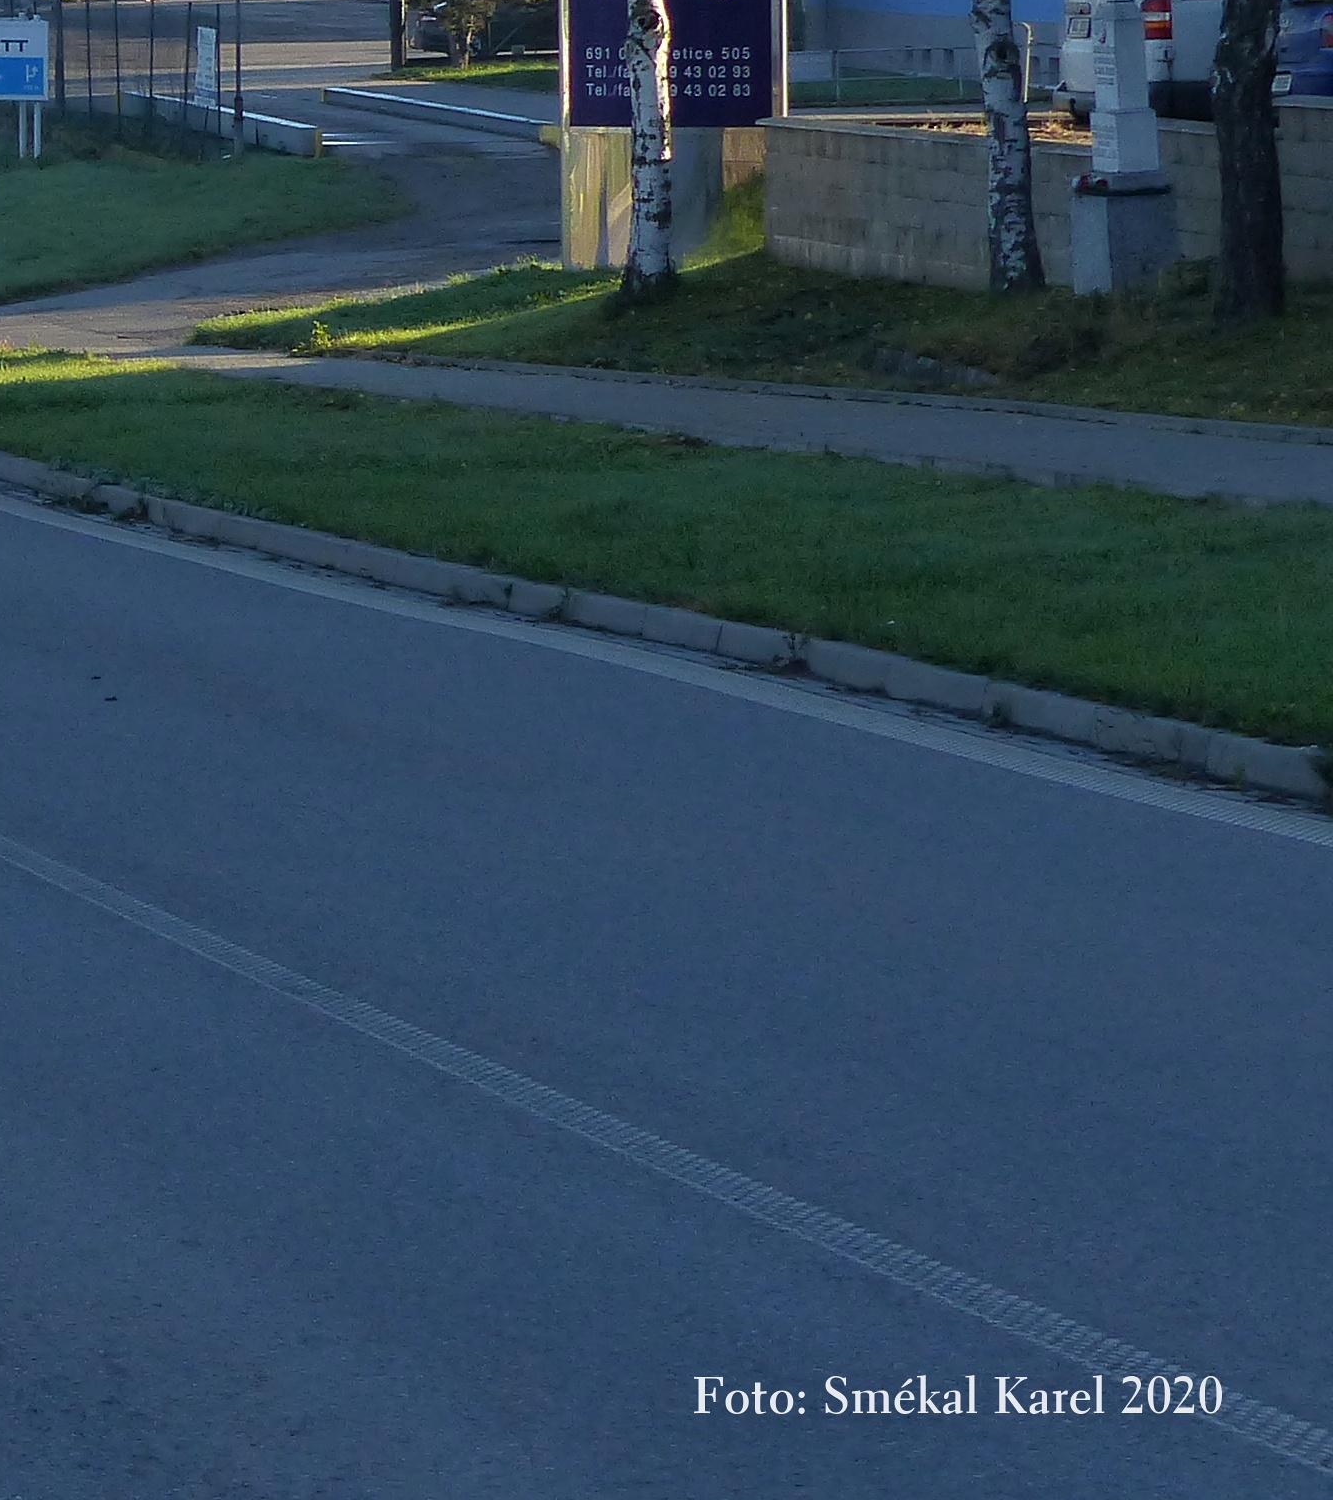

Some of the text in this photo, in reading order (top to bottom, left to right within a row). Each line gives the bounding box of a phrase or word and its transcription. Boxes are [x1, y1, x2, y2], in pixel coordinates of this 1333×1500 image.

[585, 47, 610, 60] 691
[721, 47, 750, 60] 505
[683, 65, 702, 78] 43
[708, 65, 726, 78] 02
[732, 65, 750, 78] 93
[683, 83, 702, 96] 43
[708, 83, 726, 96] 02
[732, 83, 750, 96] 83
